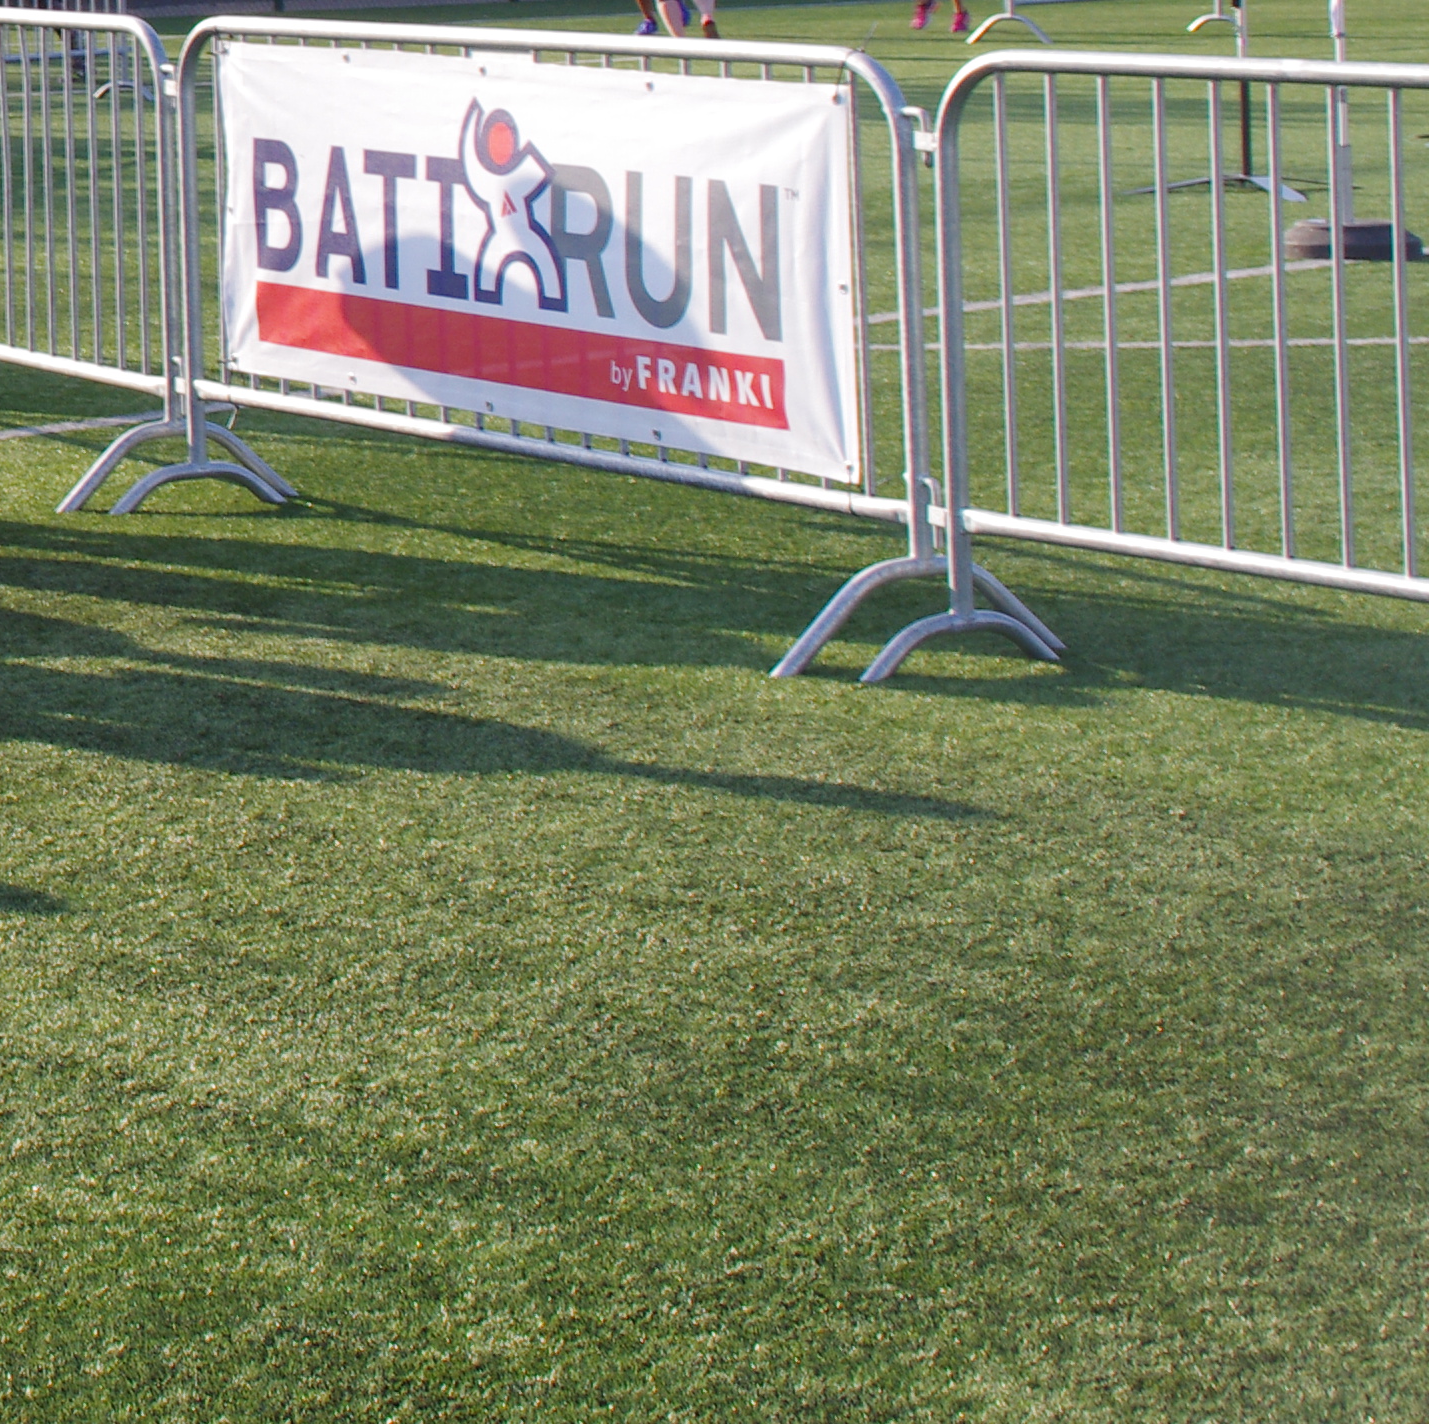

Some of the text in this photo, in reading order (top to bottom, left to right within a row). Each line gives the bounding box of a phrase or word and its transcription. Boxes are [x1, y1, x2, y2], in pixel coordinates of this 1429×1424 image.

[252, 137, 469, 300] BATI
[546, 164, 783, 342] RUN
[610, 355, 775, 410] by FRANKI
